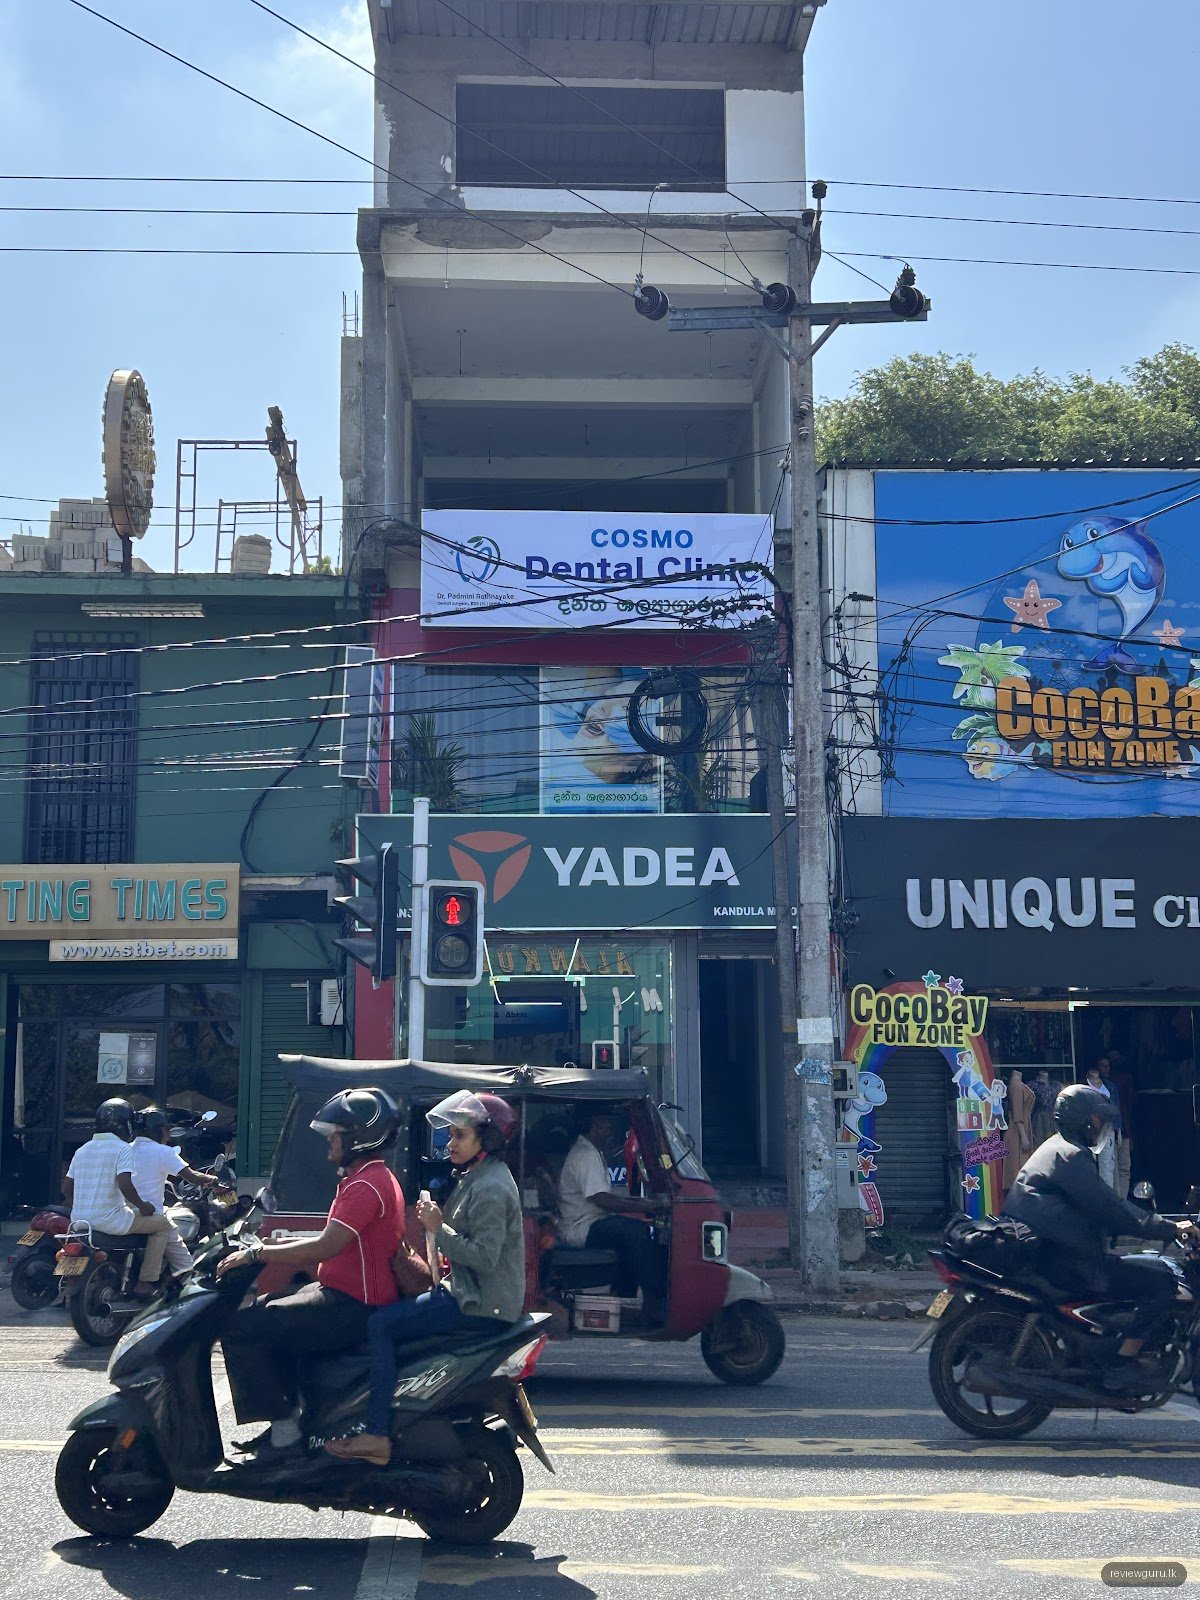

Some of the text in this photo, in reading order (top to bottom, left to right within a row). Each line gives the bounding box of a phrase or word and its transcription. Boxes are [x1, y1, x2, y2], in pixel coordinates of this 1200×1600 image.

[590, 528, 694, 549] COSMO
[525, 555, 759, 583] Dental Clinic
[557, 595, 607, 615] දන්ත
[1052, 741, 1180, 767] FUN ZONE
[542, 846, 740, 887] YADEA
[1, 878, 228, 922] TING TIMES
[713, 906, 764, 916] KANDULA
[905, 876, 1137, 932] UNIQUE
[62, 940, 229, 959] www.stbet.com
[853, 986, 985, 1034] CocoBay
[873, 1023, 964, 1045] FUN ZONE
